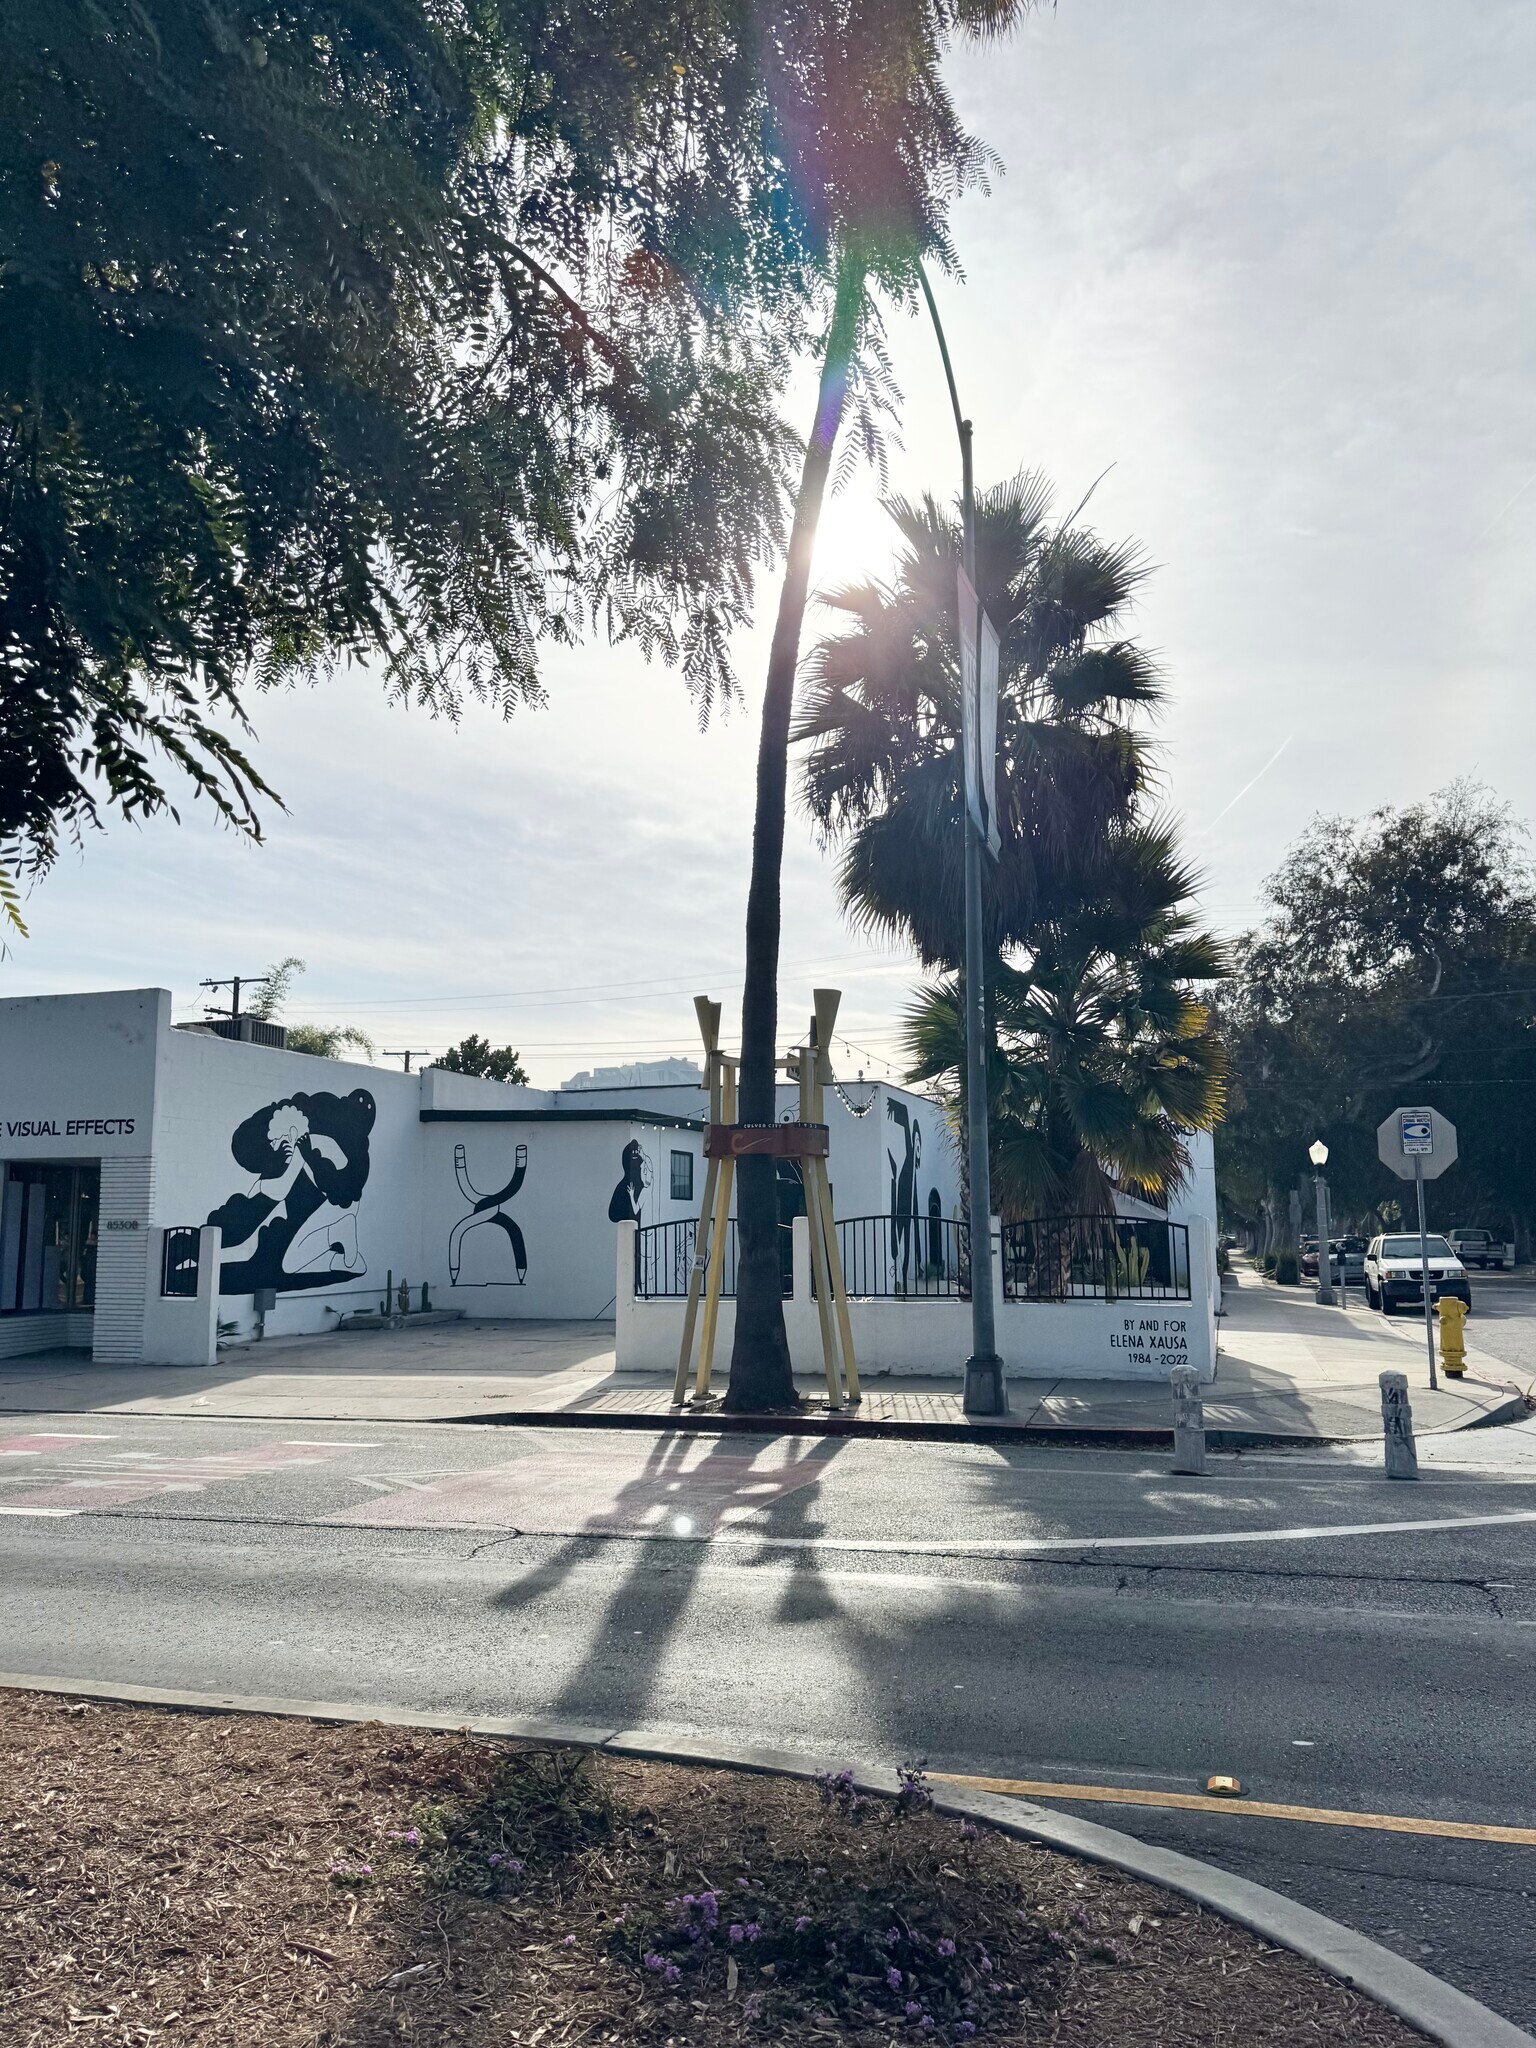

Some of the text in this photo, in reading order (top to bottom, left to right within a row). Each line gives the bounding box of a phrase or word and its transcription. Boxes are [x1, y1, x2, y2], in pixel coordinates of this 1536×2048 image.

[7, 1121, 61, 1136] VISUAL
[66, 1118, 135, 1135] EFFECTS
[1124, 1319, 1186, 1332] BY AND FOR
[1111, 1334, 1188, 1349] ELENA XAUSA
